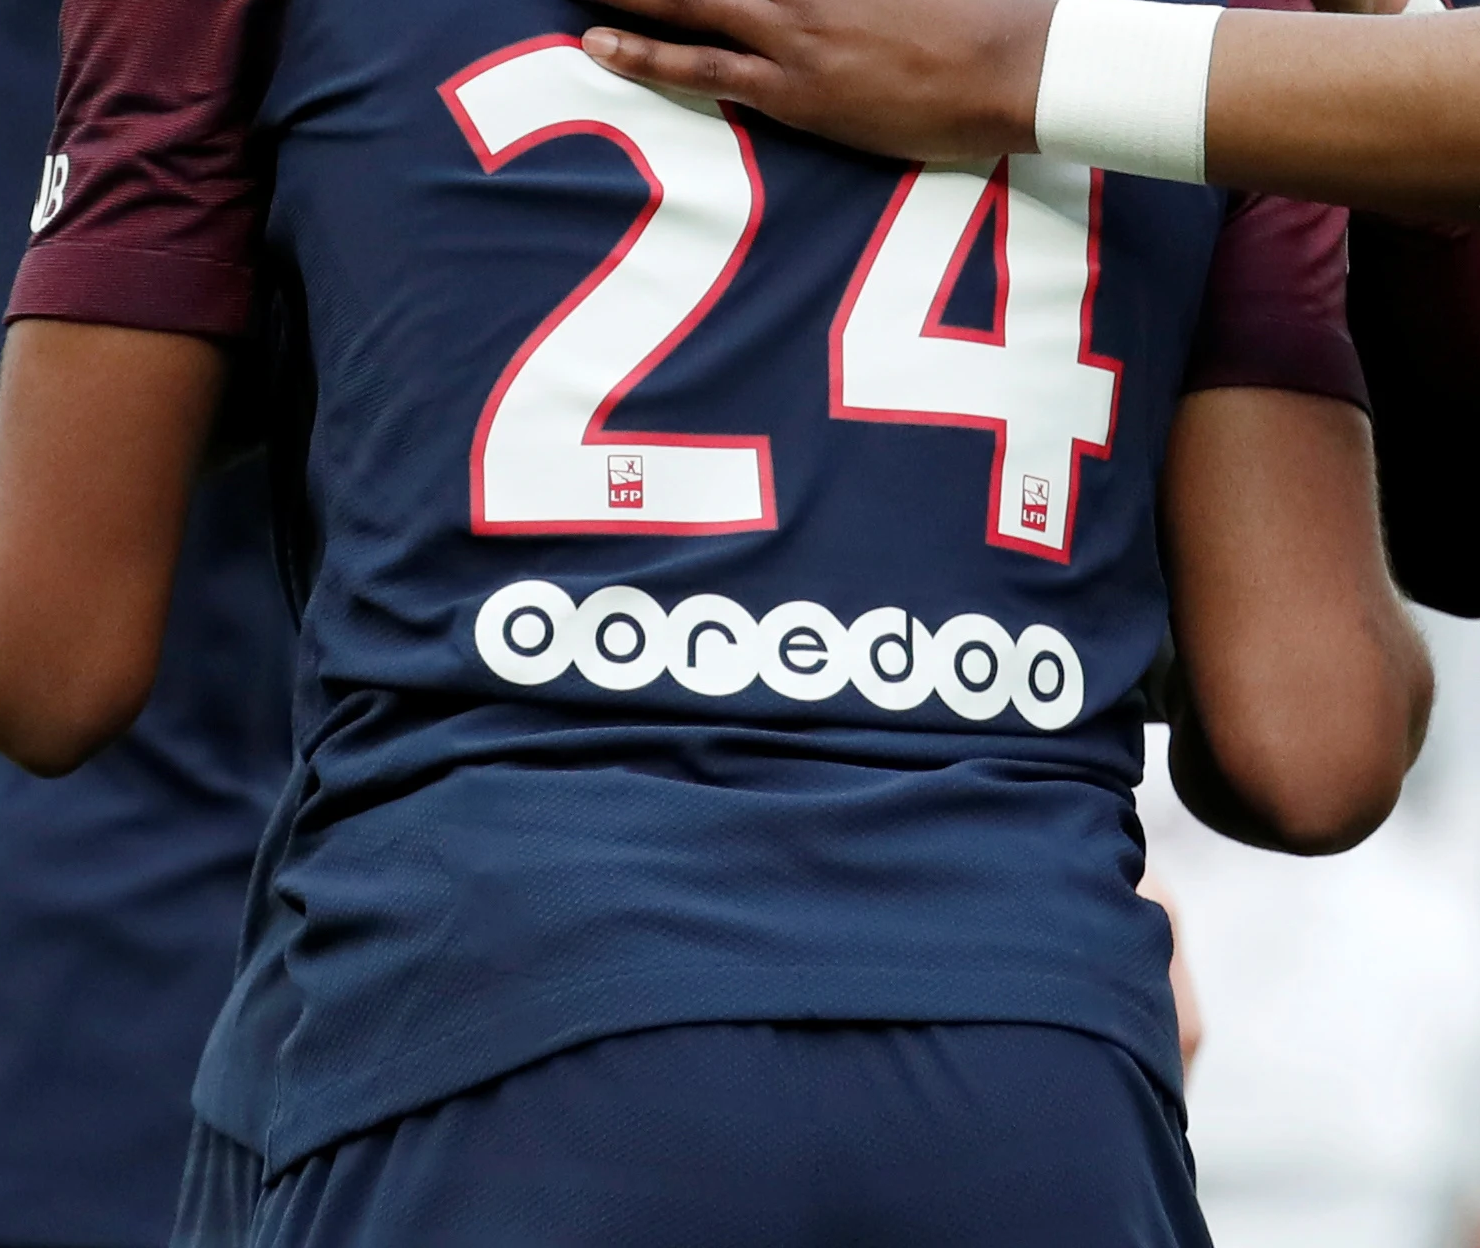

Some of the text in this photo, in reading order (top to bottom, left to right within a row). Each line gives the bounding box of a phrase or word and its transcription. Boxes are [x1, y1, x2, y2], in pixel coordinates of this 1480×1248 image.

[437, 33, 1124, 565] 24
[611, 489, 642, 502] LFP
[1022, 509, 1047, 525] LFP
[486, 590, 1077, 718] ooredoo
